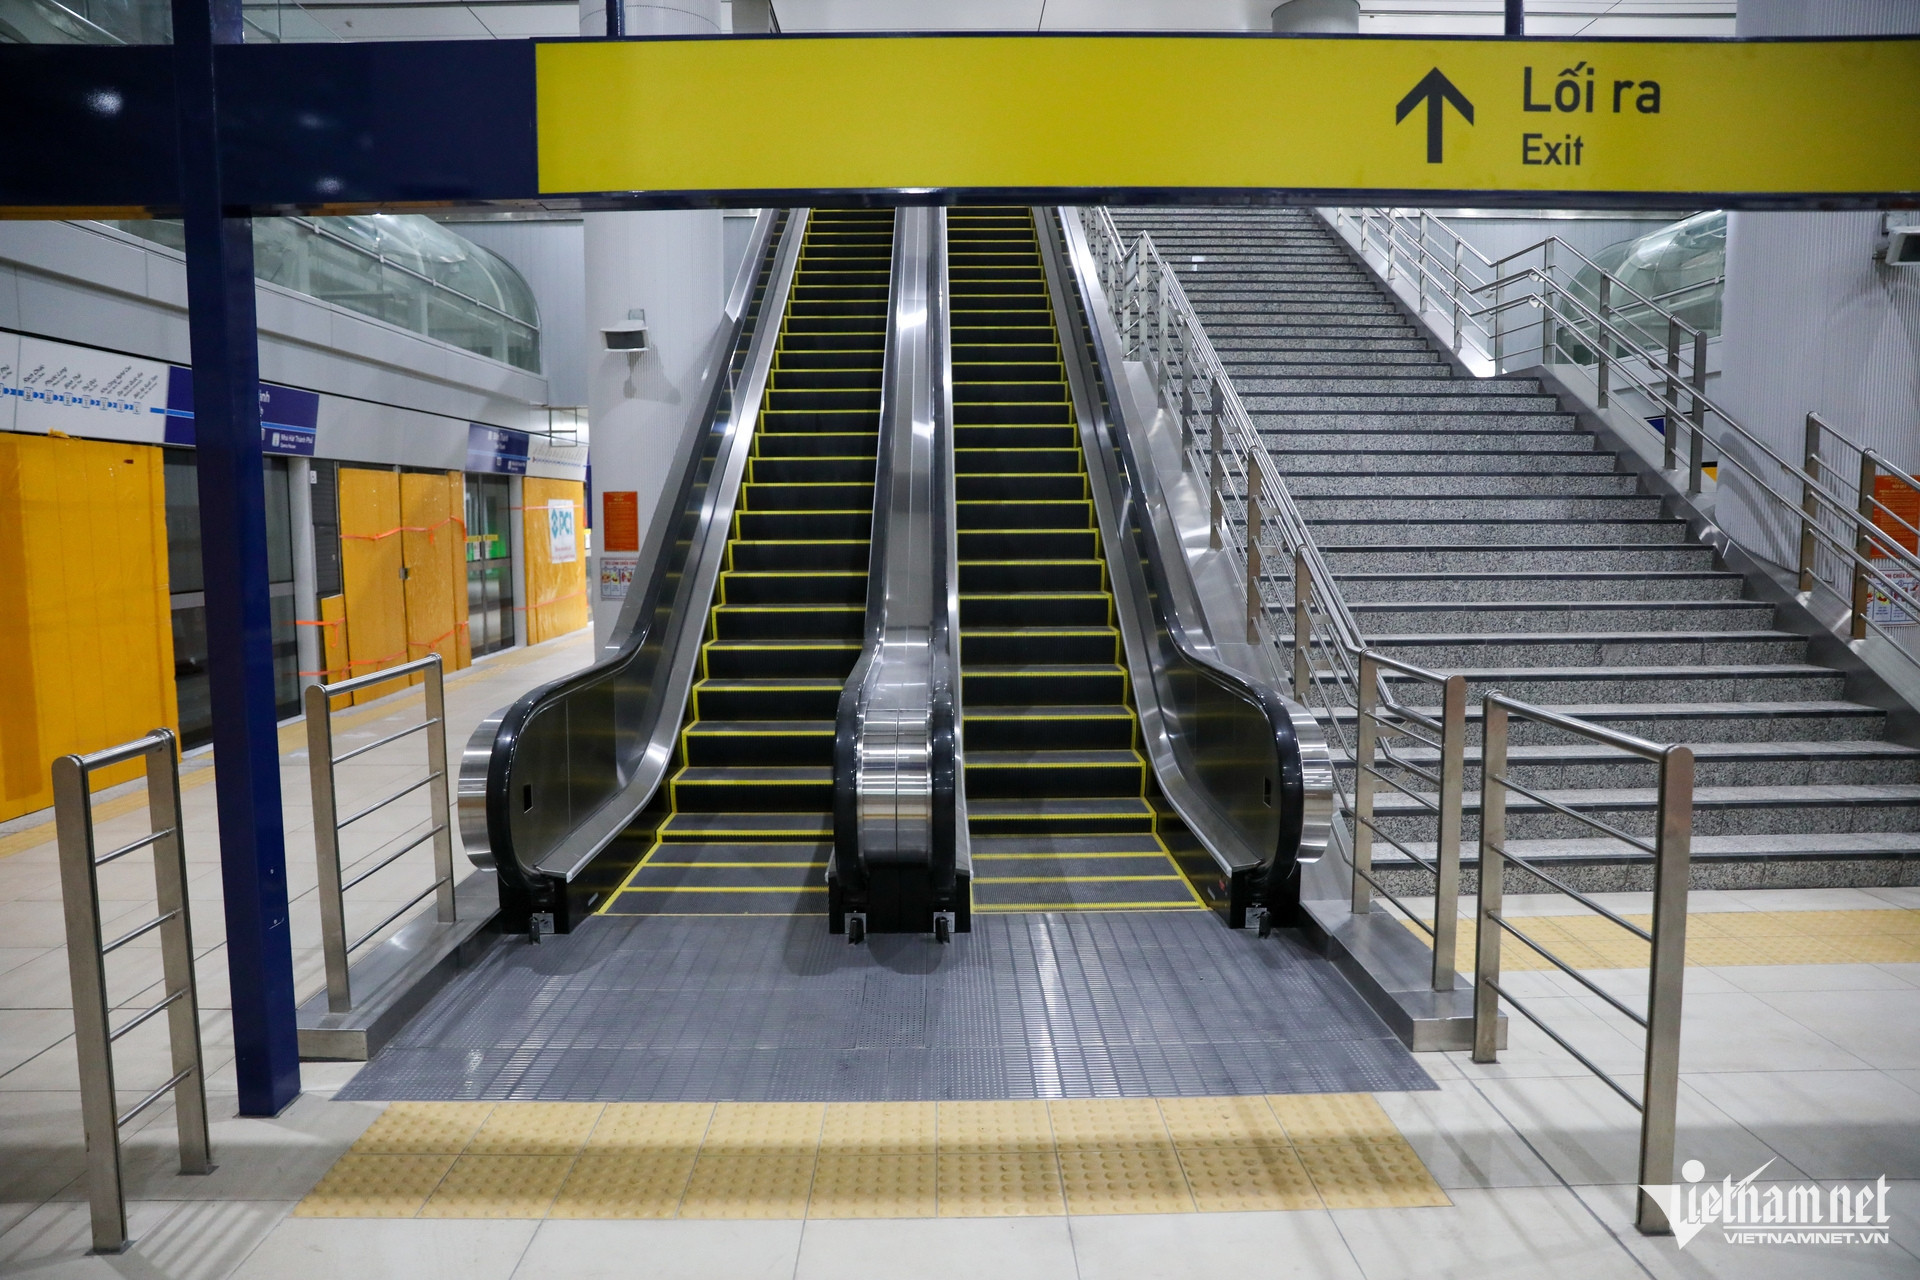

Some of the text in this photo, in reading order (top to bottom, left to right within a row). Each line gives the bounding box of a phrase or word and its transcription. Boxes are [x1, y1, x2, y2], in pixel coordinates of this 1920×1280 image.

[1523, 61, 1660, 114] Lối ra
[1522, 133, 1584, 166] Exit
